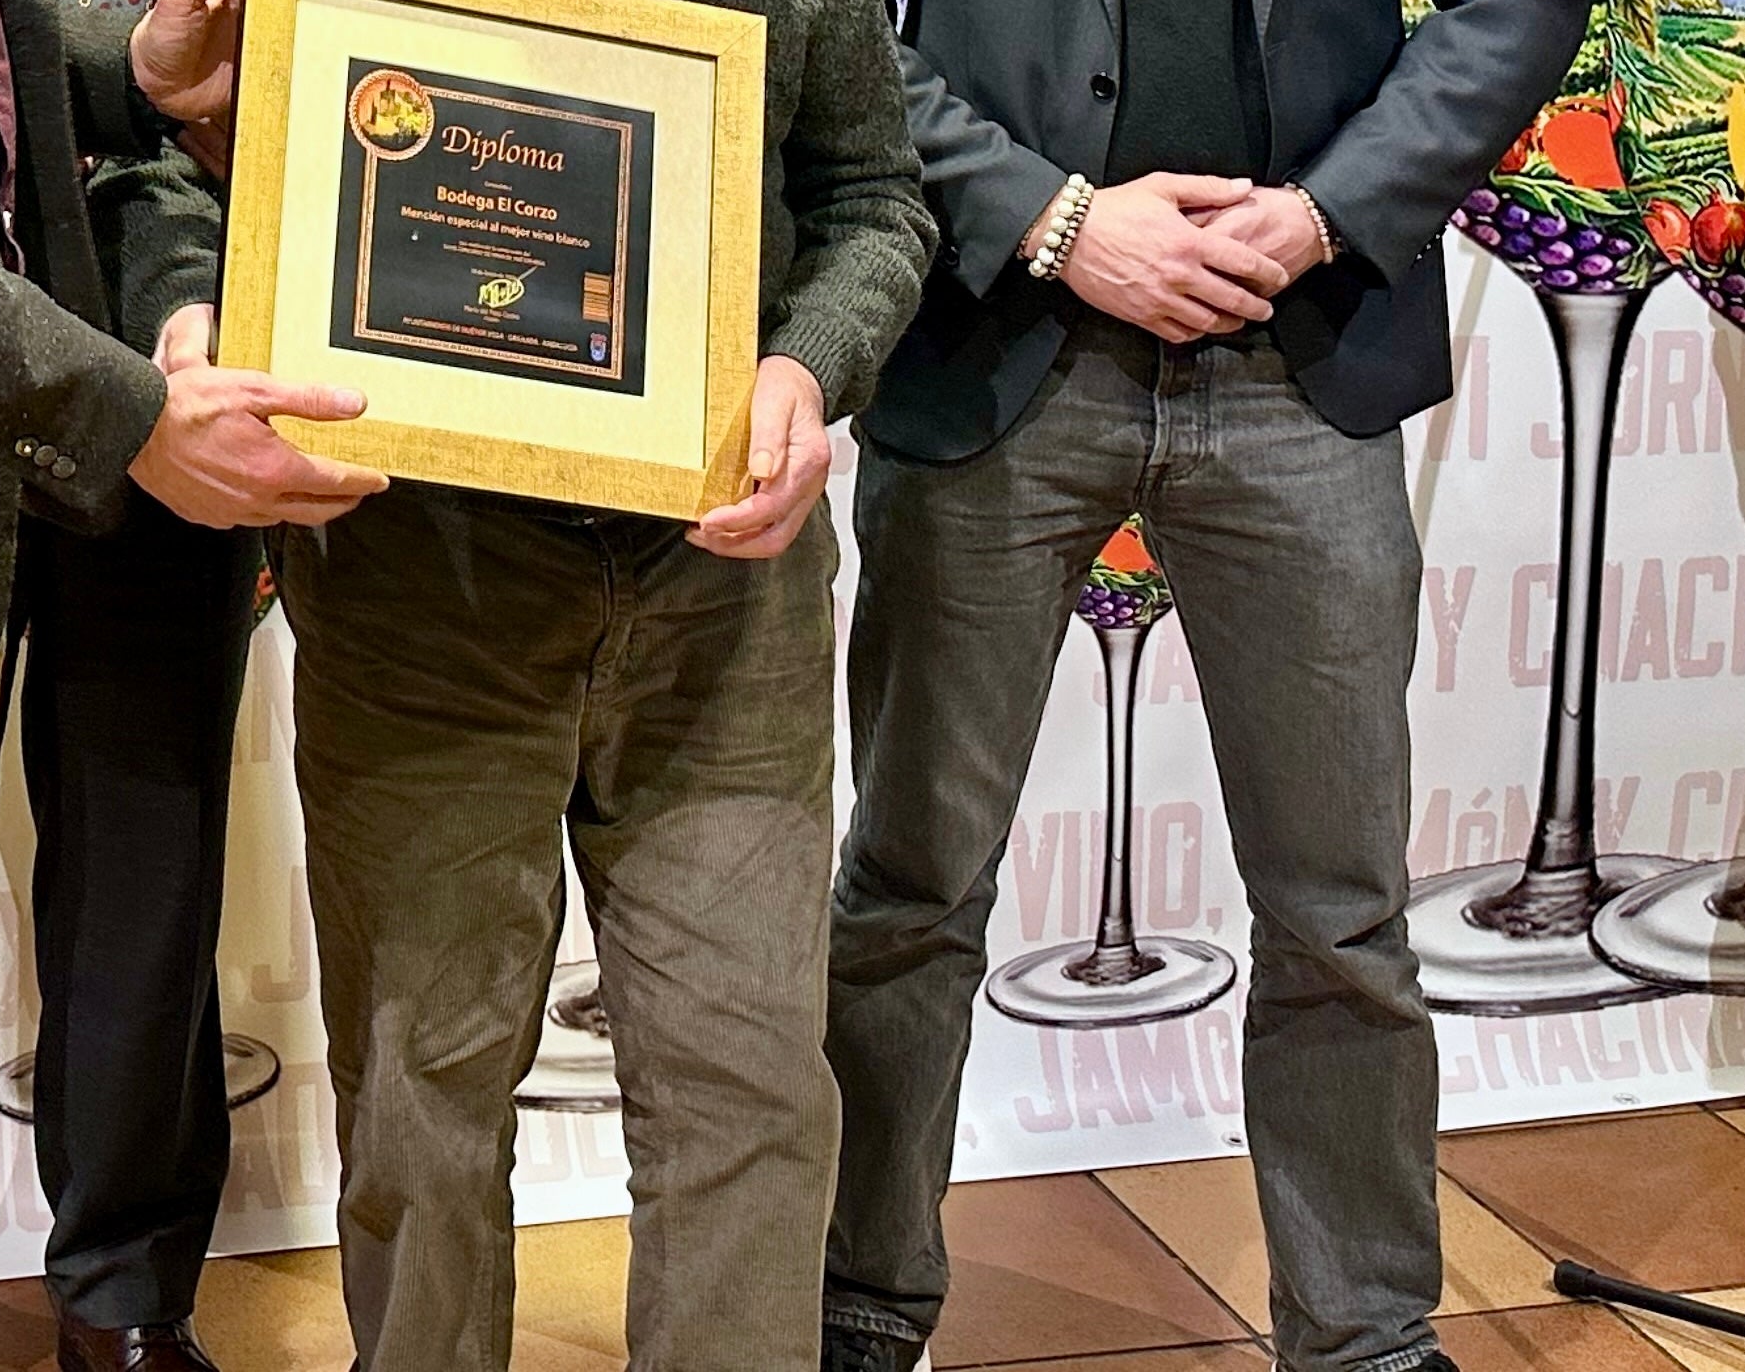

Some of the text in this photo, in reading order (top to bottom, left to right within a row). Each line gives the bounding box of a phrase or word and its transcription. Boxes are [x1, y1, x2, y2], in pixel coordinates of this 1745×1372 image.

[442, 125, 565, 172] Diploma
[437, 185, 495, 212] Bodega
[498, 197, 512, 213] El
[514, 200, 558, 221] Corzo
